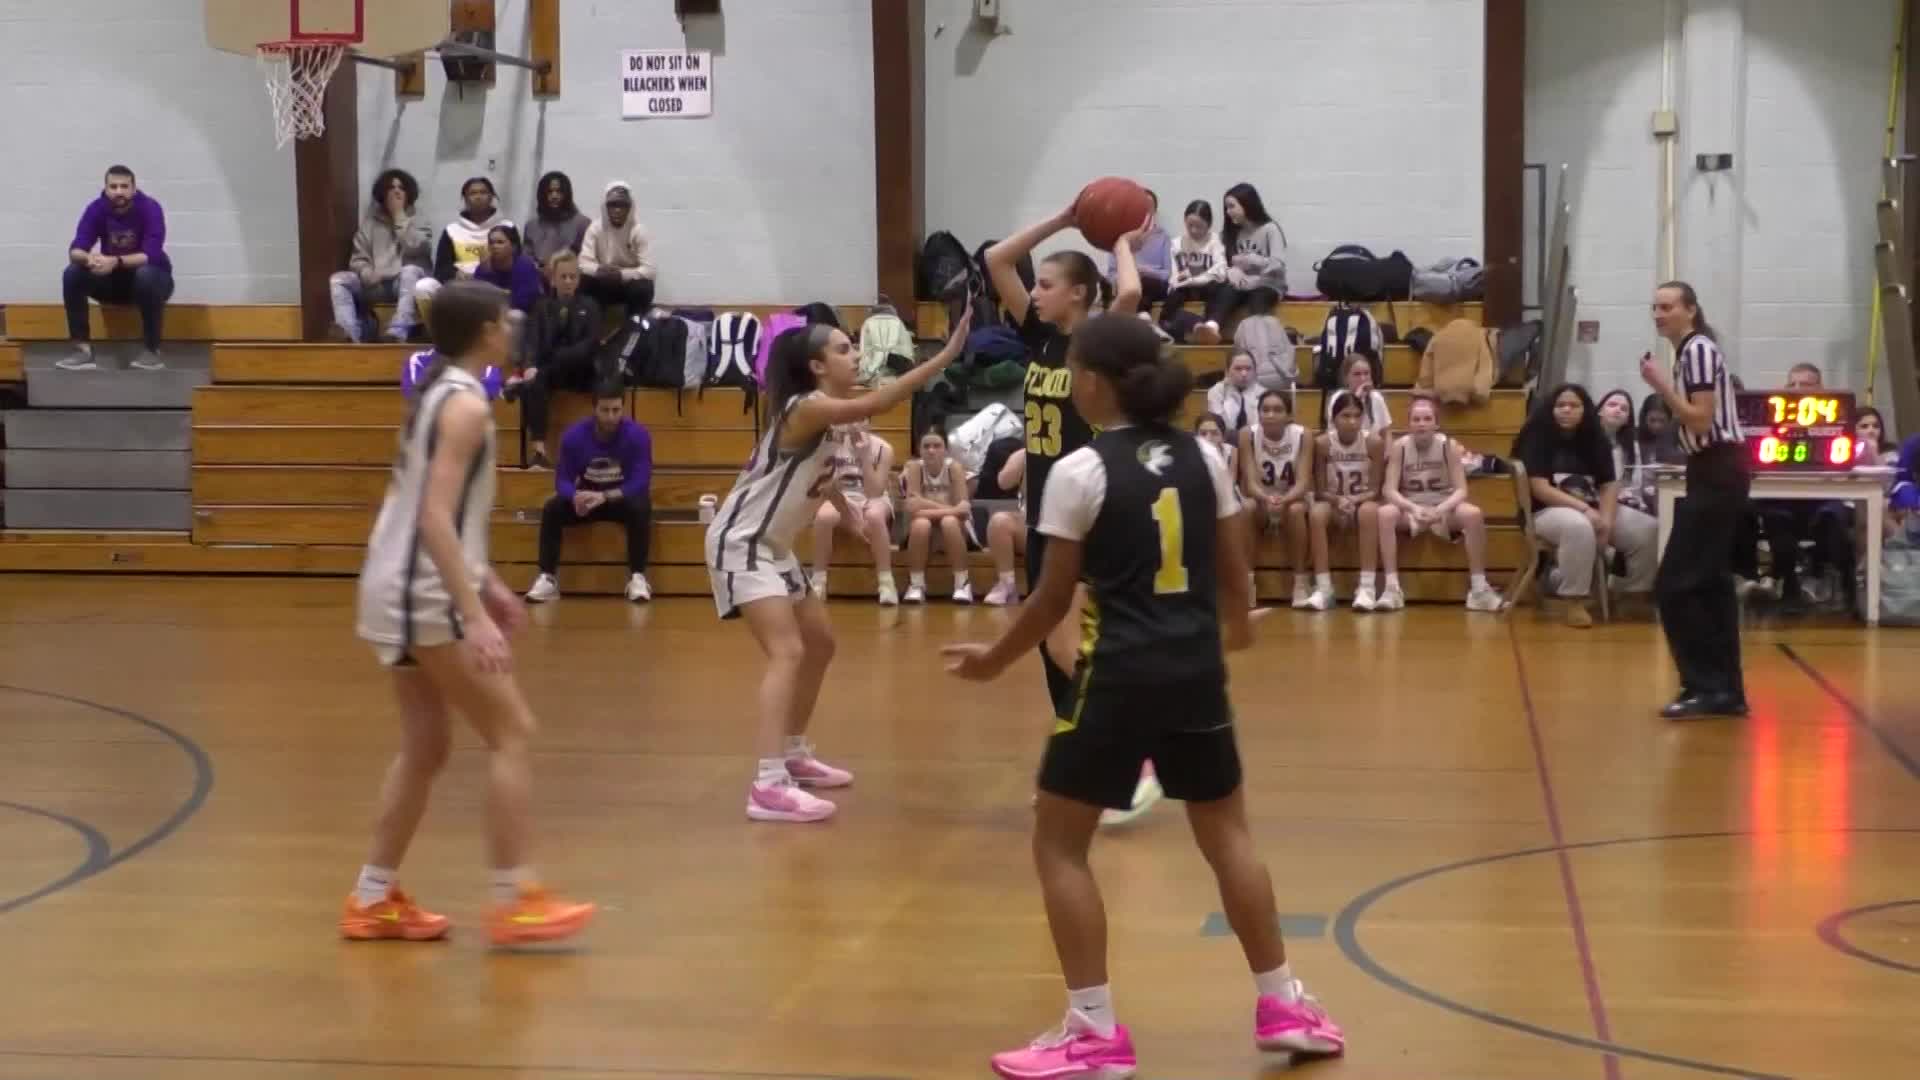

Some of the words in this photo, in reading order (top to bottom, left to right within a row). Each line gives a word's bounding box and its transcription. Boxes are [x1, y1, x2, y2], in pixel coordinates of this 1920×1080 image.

[629, 55, 643, 71] DO
[646, 55, 665, 71] NOT
[668, 55, 682, 71] SIT
[685, 54, 700, 71] ON
[623, 76, 675, 92] BLEACHERS
[678, 75, 707, 92] WHEN
[648, 97, 683, 113] CLOSED
[1768, 396, 1838, 426] 7:04
[1024, 400, 1062, 456] 23
[1830, 436, 1851, 464] 0
[1262, 461, 1296, 487] 34
[1336, 471, 1367, 496] 12
[1151, 487, 1188, 594] 1
